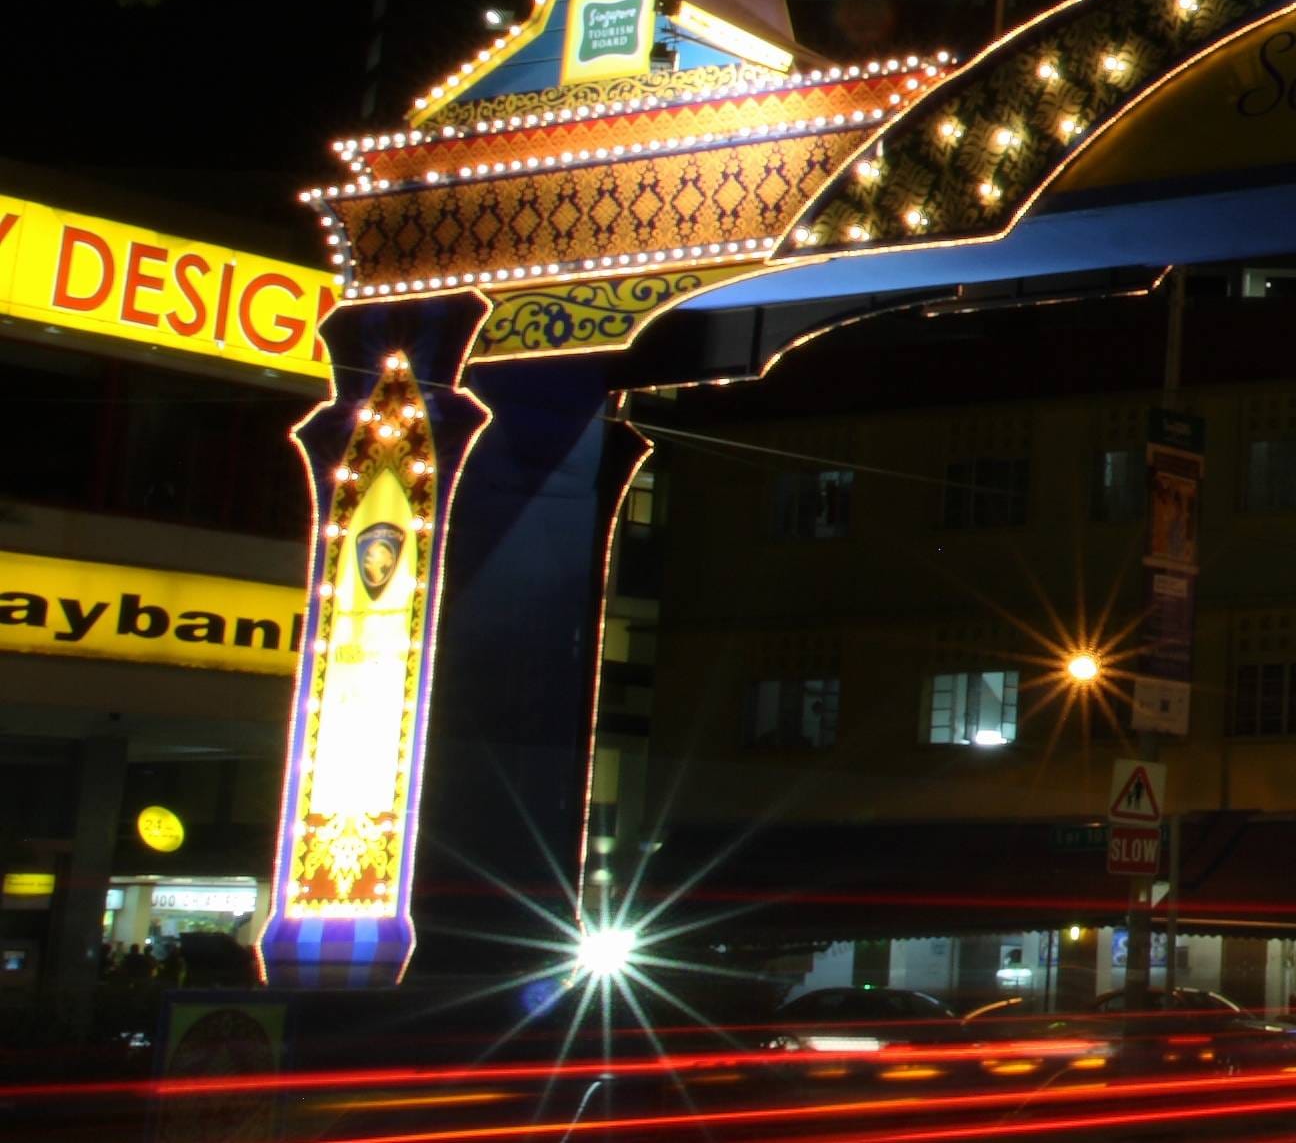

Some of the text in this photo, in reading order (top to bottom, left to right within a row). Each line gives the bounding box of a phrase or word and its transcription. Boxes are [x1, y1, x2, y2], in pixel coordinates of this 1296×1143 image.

[588, 25, 635, 40] TOURISM
[591, 37, 629, 49] BOARD
[1111, 837, 1159, 863] SLOW
